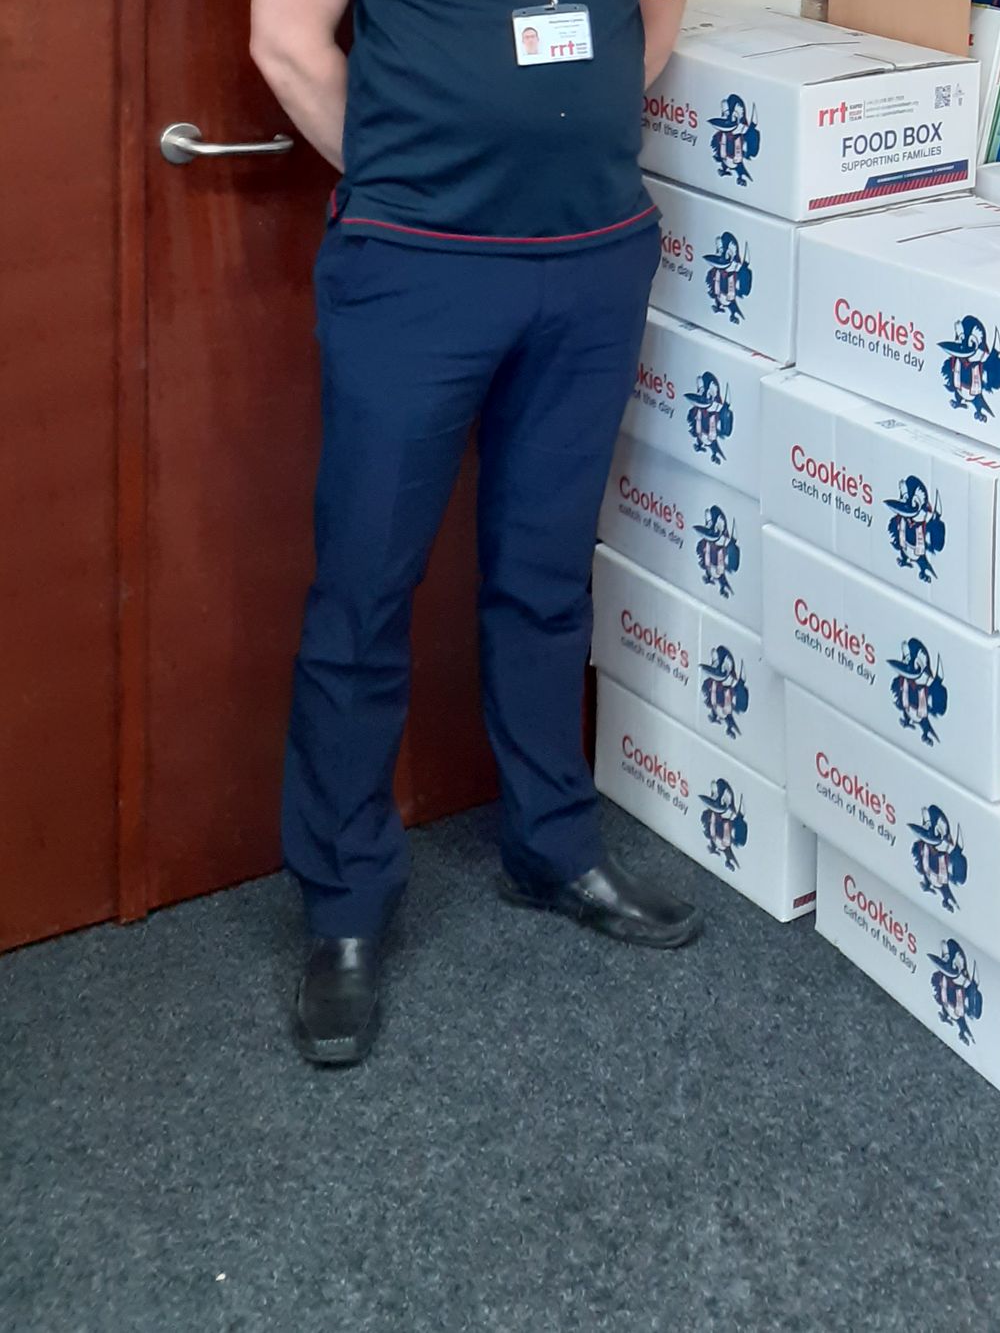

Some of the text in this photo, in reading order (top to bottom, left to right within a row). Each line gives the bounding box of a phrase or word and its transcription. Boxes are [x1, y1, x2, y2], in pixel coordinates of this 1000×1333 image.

[550, 41, 575, 57] rrt
[643, 95, 698, 129] okie's
[680, 129, 698, 147] day
[818, 101, 848, 127] rrt
[841, 146, 942, 173] SUPPORTING FAMILIES
[842, 121, 943, 158] FOOD BOX
[834, 328, 925, 372] catch of the day
[835, 298, 925, 352] Cookie's
[636, 362, 675, 400] kie's
[791, 445, 873, 505] Cookie's
[791, 476, 873, 527] catch of the day
[619, 476, 685, 530] Cookie's
[621, 610, 689, 668] Cookie's
[794, 598, 876, 665] Cookie's
[794, 628, 876, 685] catch of the day
[622, 735, 689, 798] Cookie's
[816, 752, 896, 826] Cookie's
[816, 781, 897, 846] catch of the day
[843, 874, 917, 954] Cookie's
[843, 904, 918, 974] catch of the day
